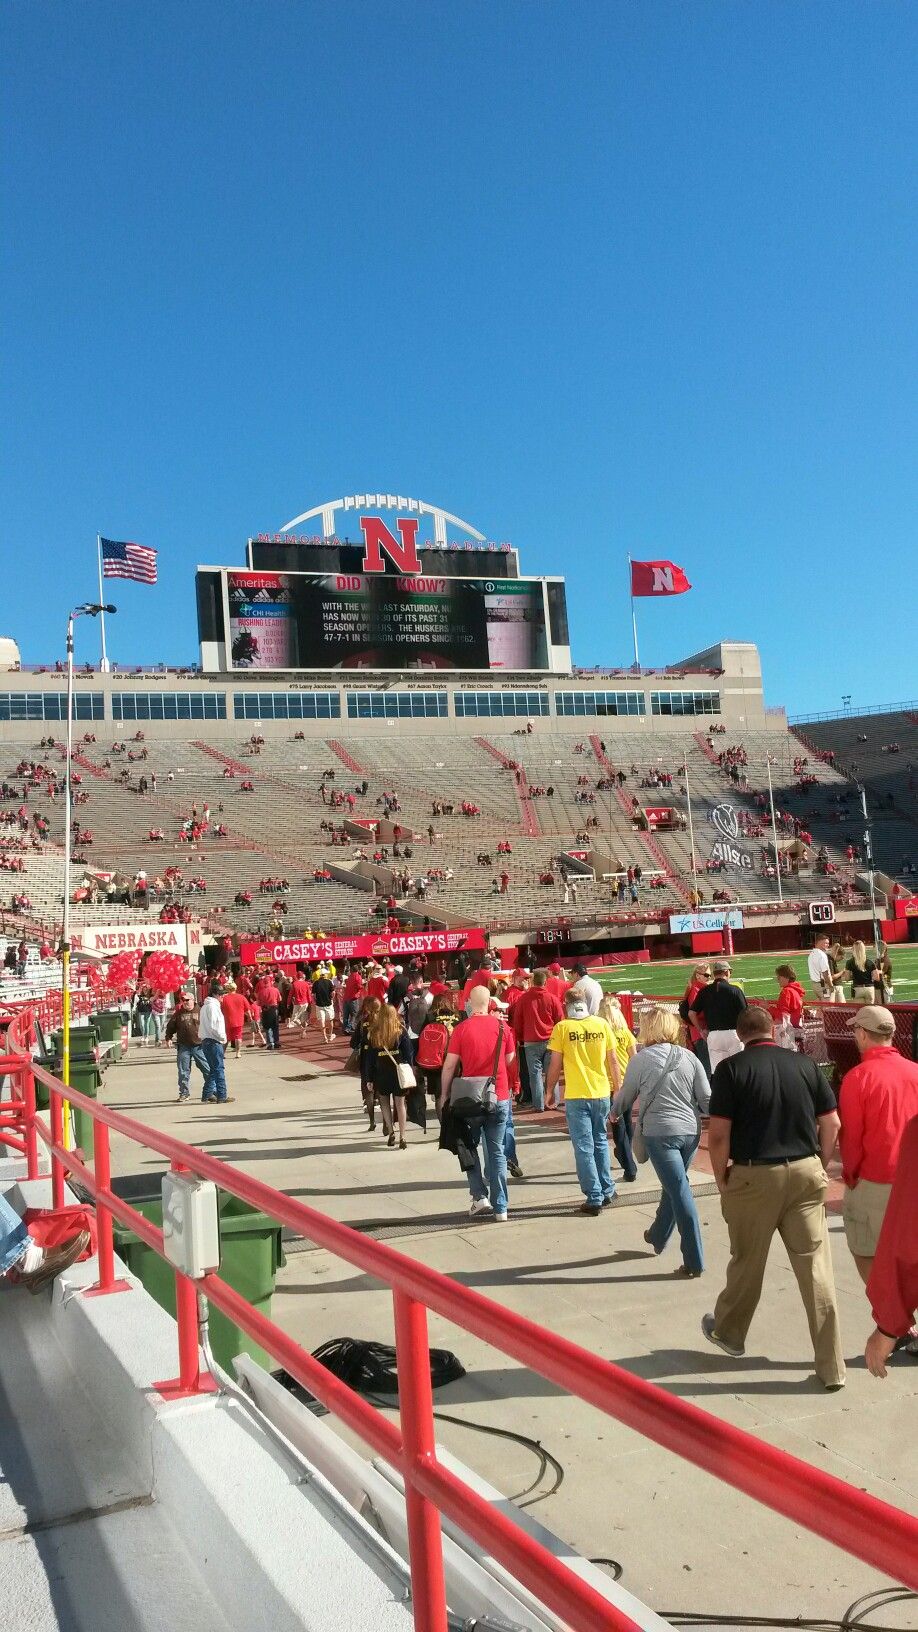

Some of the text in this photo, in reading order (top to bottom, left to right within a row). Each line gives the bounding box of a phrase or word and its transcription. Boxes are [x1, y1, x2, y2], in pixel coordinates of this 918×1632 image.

[257, 533, 348, 546] MEMORIA
[359, 516, 422, 574] N
[228, 577, 277, 589] Ameritas
[336, 576, 361, 591] DID
[396, 577, 446, 593] KNOW?
[651, 566, 675, 592] N
[322, 602, 342, 611] WITH
[344, 602, 359, 611] THE
[400, 604, 440, 614] SATURDAY,
[322, 612, 339, 621] HAS
[341, 613, 359, 621] NOW
[393, 614, 403, 622] OF
[405, 614, 417, 622] ITS
[419, 615, 437, 623] PAST
[440, 615, 448, 623] 31
[323, 622, 354, 632] SEASON
[399, 624, 413, 632] THE
[415, 624, 449, 633] HUSKERS
[324, 633, 349, 641] 47-7-1
[352, 633, 361, 642] IN
[395, 634, 430, 643] OPENERS
[813, 905, 831, 920] 40
[71, 934, 83, 951] N
[95, 931, 178, 950] NEBRASKA
[190, 929, 200, 945] N
[390, 934, 446, 953] CASEY'S
[274, 940, 358, 961] CASEY'S GENERAL
[568, 1030, 604, 1042] BigIron
